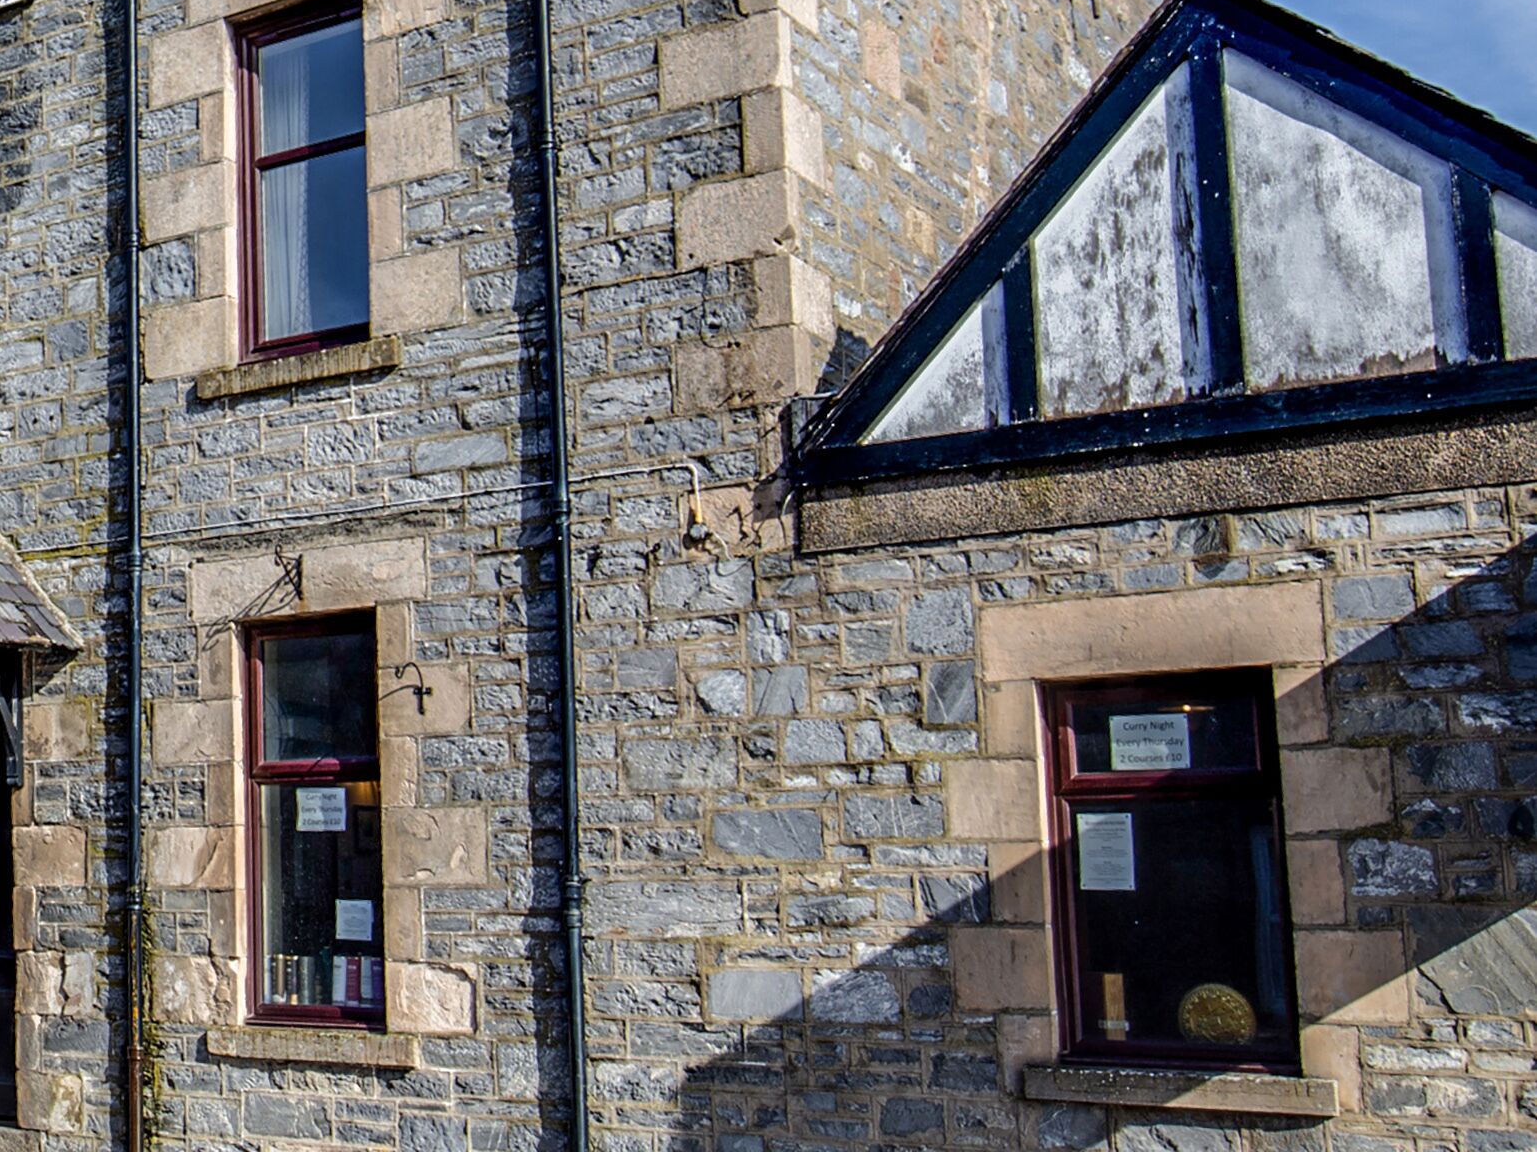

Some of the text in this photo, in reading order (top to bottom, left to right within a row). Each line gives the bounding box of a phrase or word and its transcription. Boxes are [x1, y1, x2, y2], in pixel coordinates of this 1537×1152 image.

[1123, 720, 1175, 731] Curry Night
[1116, 736, 1184, 747] Every Thursday
[1127, 754, 1164, 764] Courses
